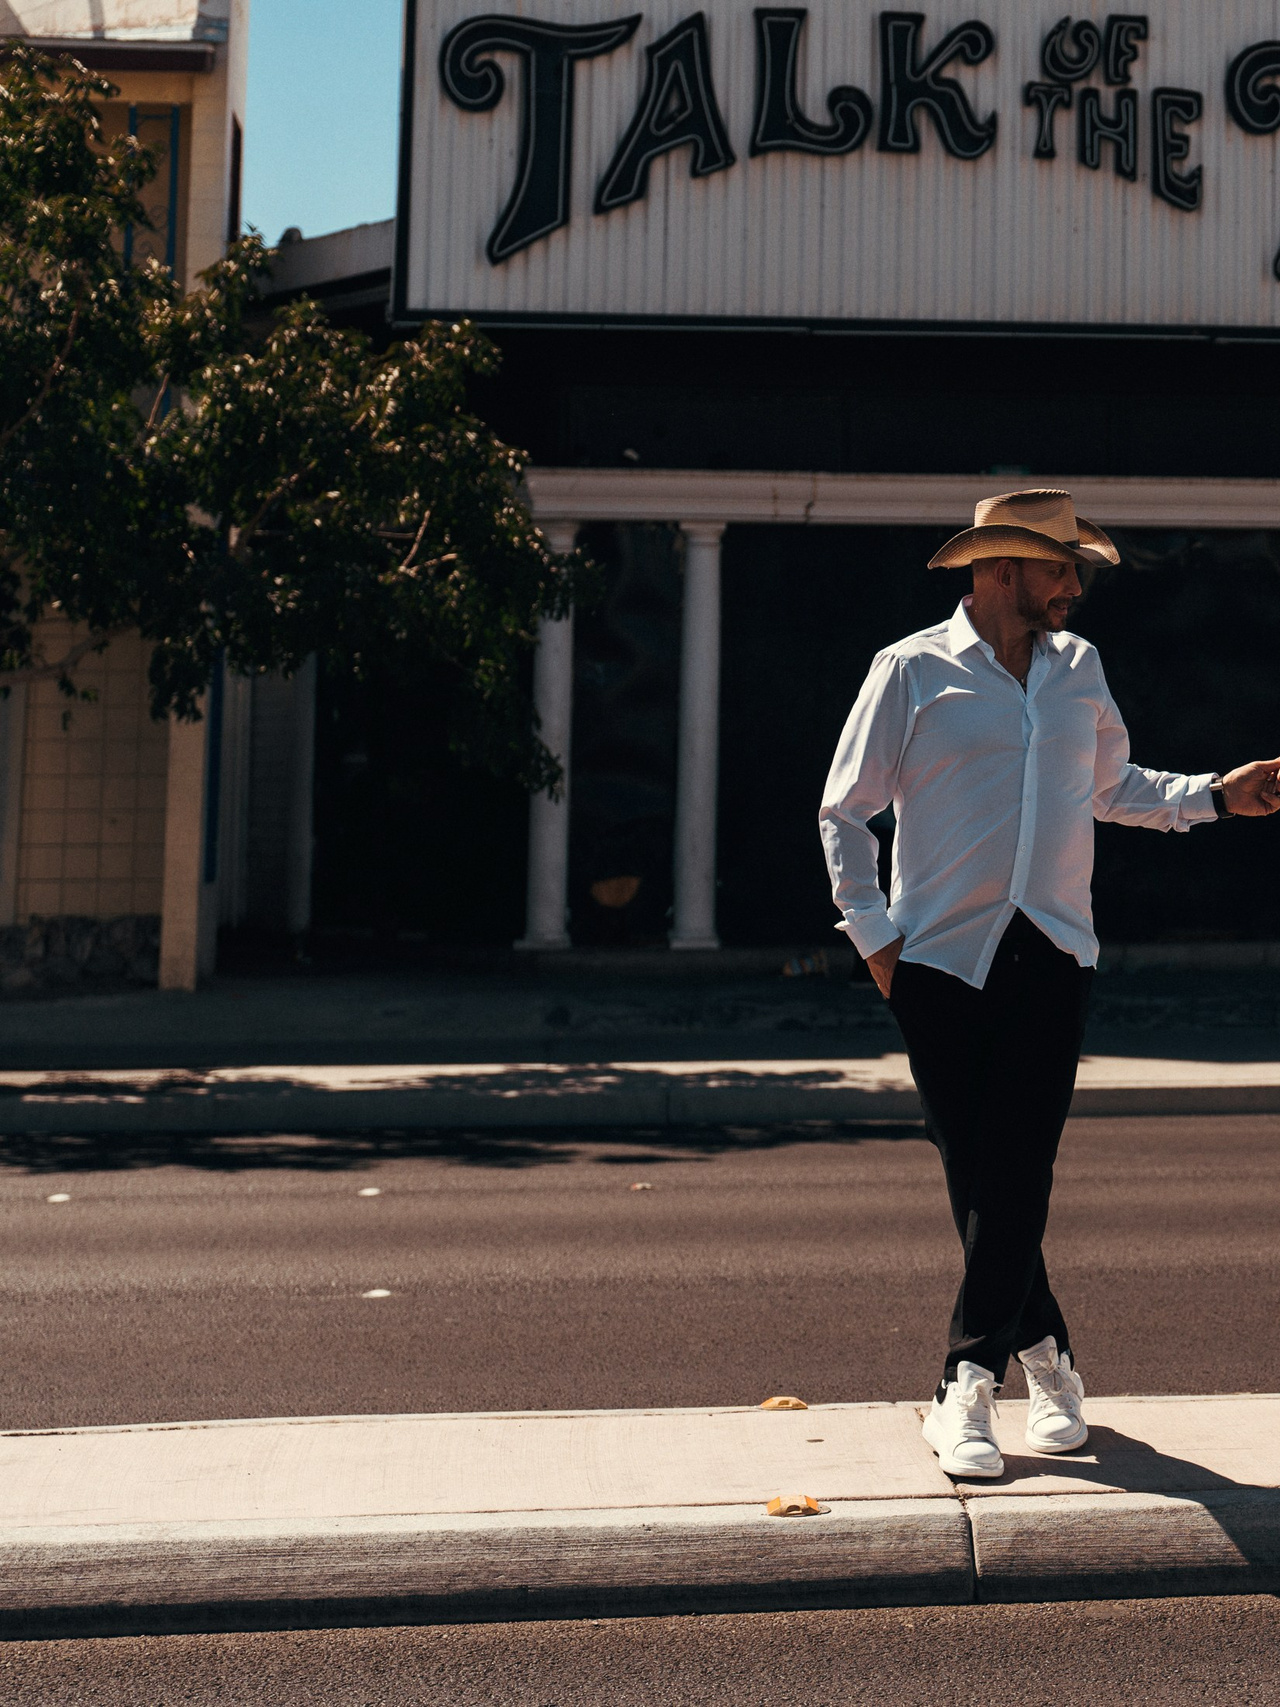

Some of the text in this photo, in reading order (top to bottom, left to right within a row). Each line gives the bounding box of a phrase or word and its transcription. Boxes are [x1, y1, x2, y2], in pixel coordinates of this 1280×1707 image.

[1041, 14, 1149, 85] OF
[438, 7, 998, 266] TALK
[1022, 80, 1203, 212] THE
